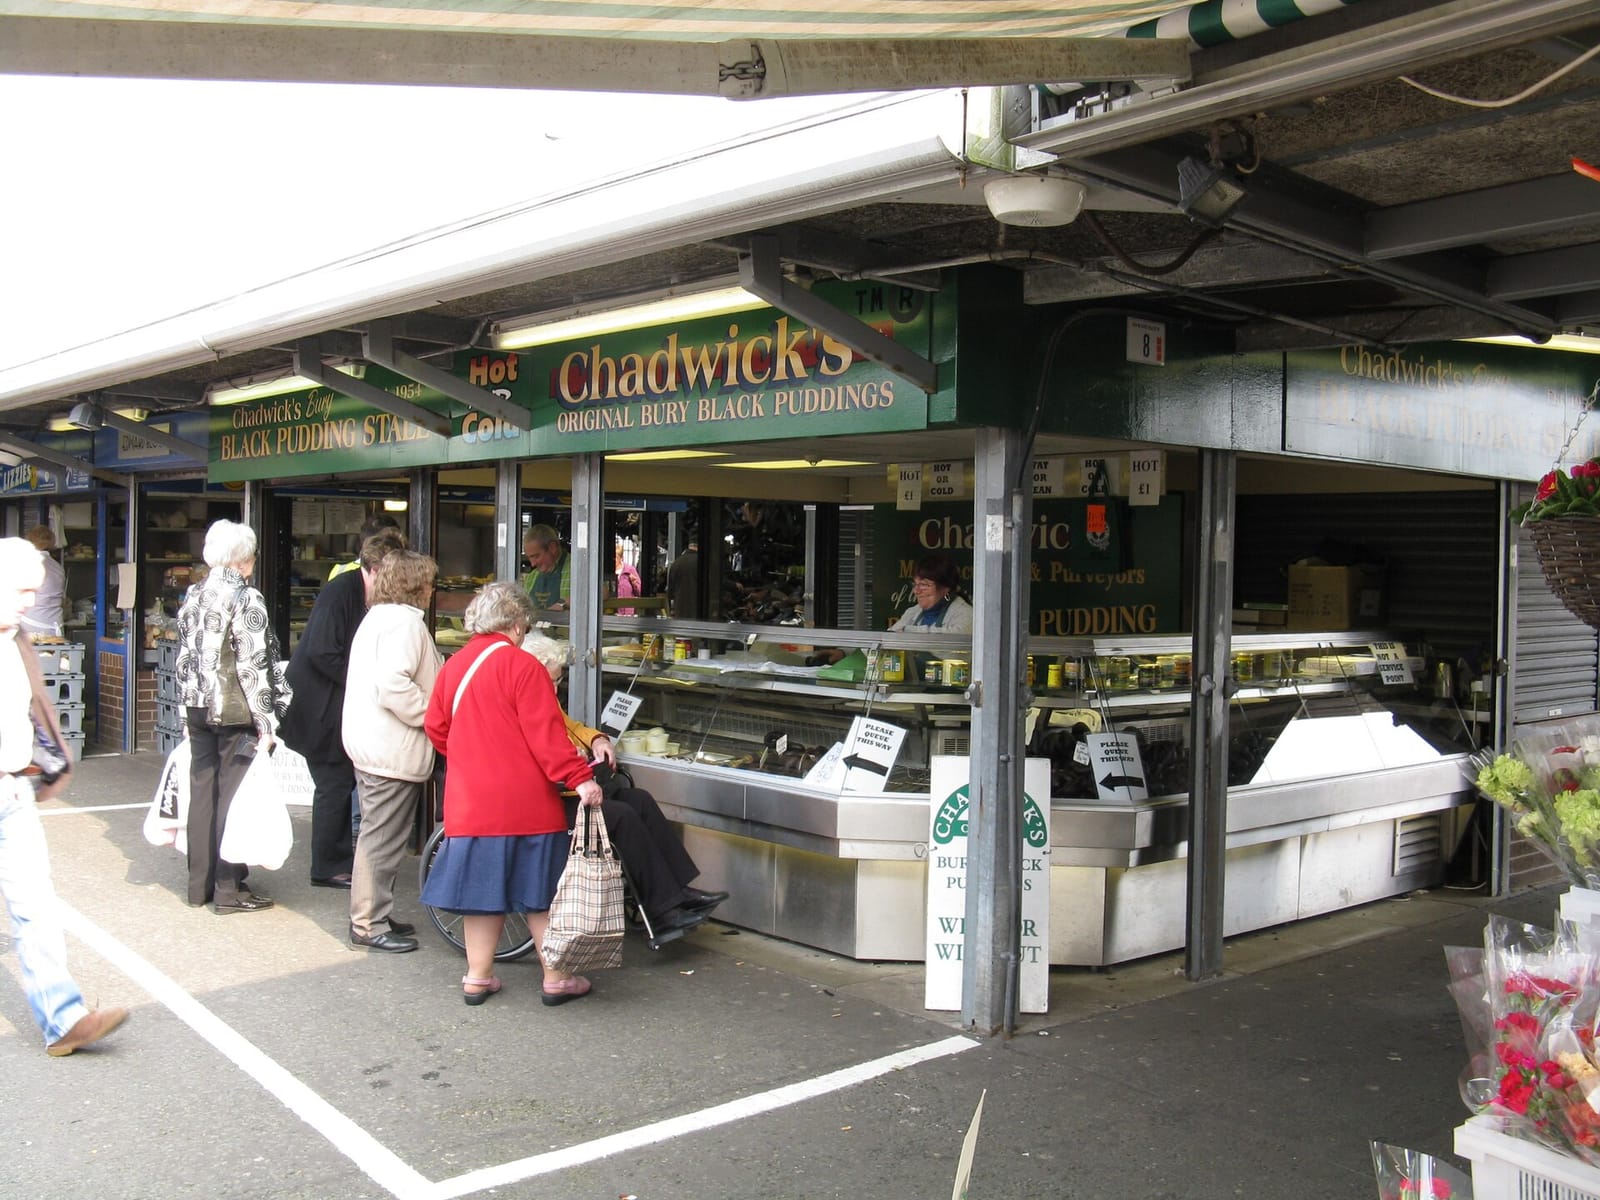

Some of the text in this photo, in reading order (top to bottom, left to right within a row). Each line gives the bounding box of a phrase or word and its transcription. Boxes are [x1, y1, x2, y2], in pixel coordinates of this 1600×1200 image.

[1143, 333, 1150, 358] 8
[558, 315, 854, 404] Chadwick's
[469, 352, 519, 387] Hot
[1340, 344, 1464, 393] Chadwick's
[395, 383, 423, 400] 1954
[232, 388, 336, 431] Chadwick's Bury
[556, 380, 895, 434] ORIGINAL BURY BLACK PUDDINGS
[220, 429, 272, 462] BLACK
[275, 417, 357, 455] PUDDING
[933, 463, 952, 472] HOT
[1132, 460, 1159, 473] HOT
[900, 470, 921, 481] HOT
[936, 475, 949, 484] OR
[1033, 473, 1047, 482] OR
[930, 487, 954, 495] COLD
[1032, 486, 1053, 494] EAN
[1138, 483, 1150, 495] £1
[1039, 604, 1157, 636] PUDDING
[1376, 653, 1390, 661] NOT
[1378, 663, 1405, 672] SERVICE
[1385, 674, 1405, 683] POINT
[864, 723, 895, 736] PLEASE
[864, 730, 890, 743] QUEUE
[856, 736, 892, 751] THIS WAY
